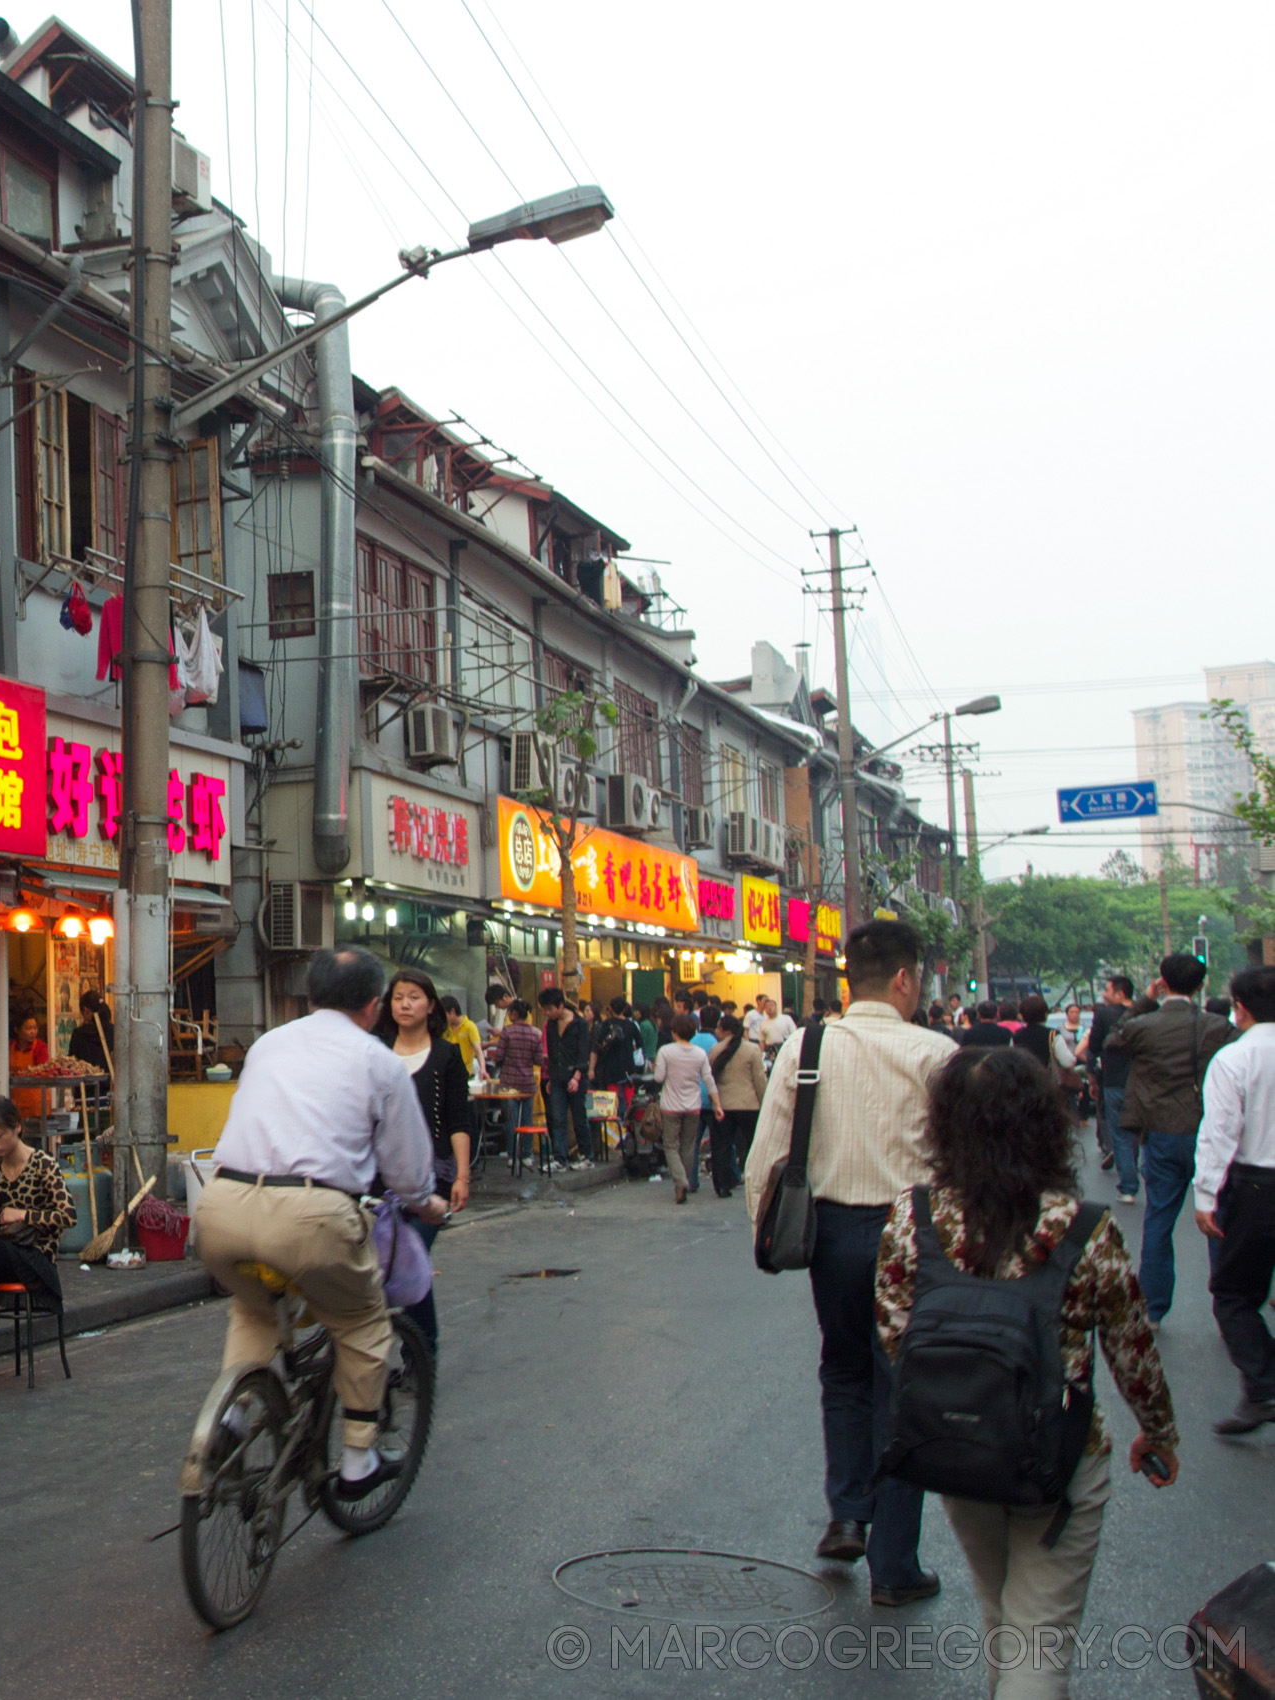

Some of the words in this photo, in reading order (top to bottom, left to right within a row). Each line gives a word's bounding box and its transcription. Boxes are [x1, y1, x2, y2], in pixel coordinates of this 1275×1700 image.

[1087, 792, 1127, 805] 人民路
[516, 835, 533, 866] 总店
